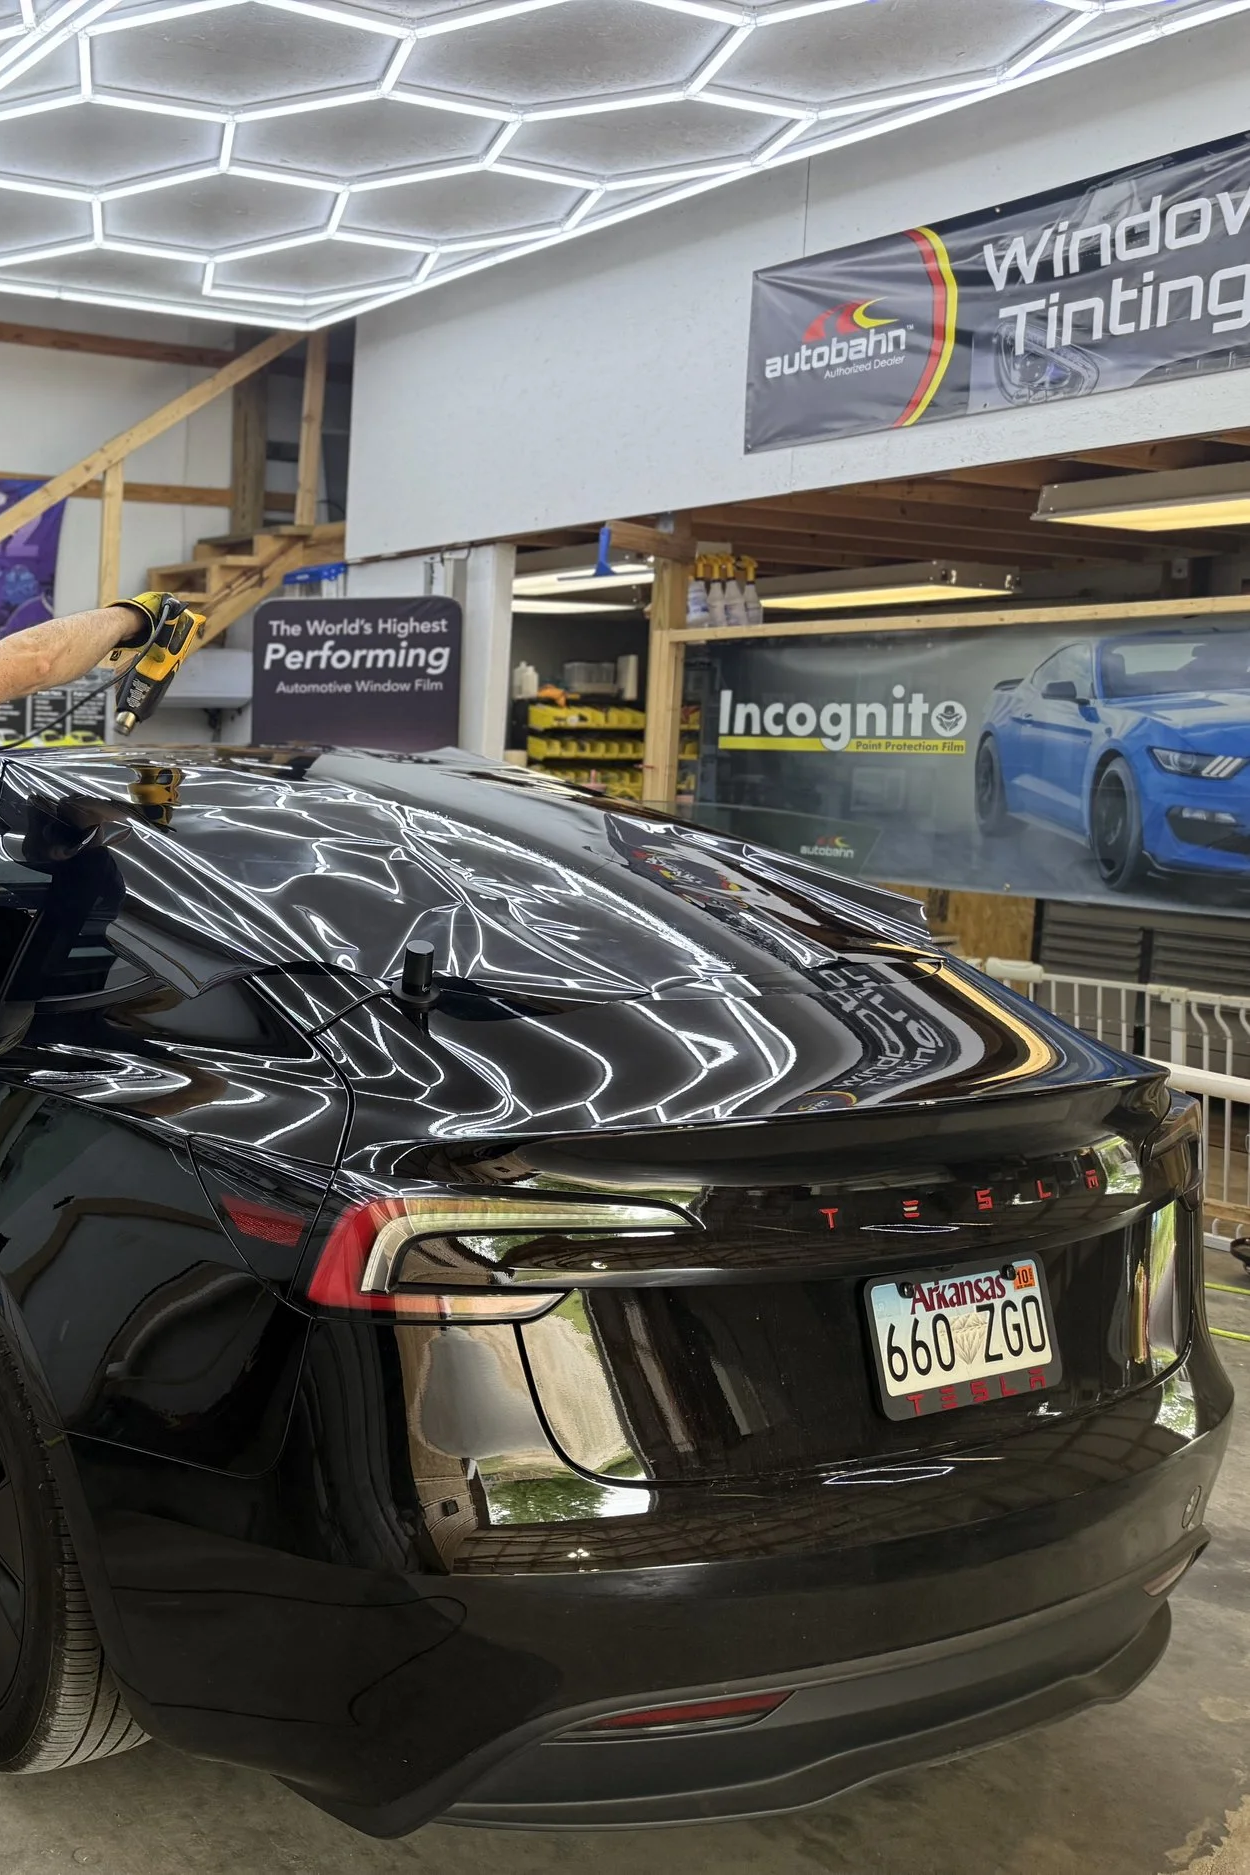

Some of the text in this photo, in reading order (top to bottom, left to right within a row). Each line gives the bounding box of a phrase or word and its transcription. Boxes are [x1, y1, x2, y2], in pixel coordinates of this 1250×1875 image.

[999, 264, 1250, 356] Tinting
[765, 328, 907, 379] autobahn
[824, 354, 906, 380] Authorized Dealer
[269, 616, 449, 638] The World's Highest
[263, 639, 451, 676] Performing
[275, 678, 444, 694] Automotive Window Film
[856, 740, 965, 753] Paint Protection Film
[800, 845, 855, 860] autobahn
[818, 1168, 1100, 1230] TESLA
[909, 1273, 1007, 1315] Arkansas
[1017, 1269, 1029, 1284] 10
[886, 1312, 956, 1383] 660
[906, 1367, 1047, 1417] TESLA
